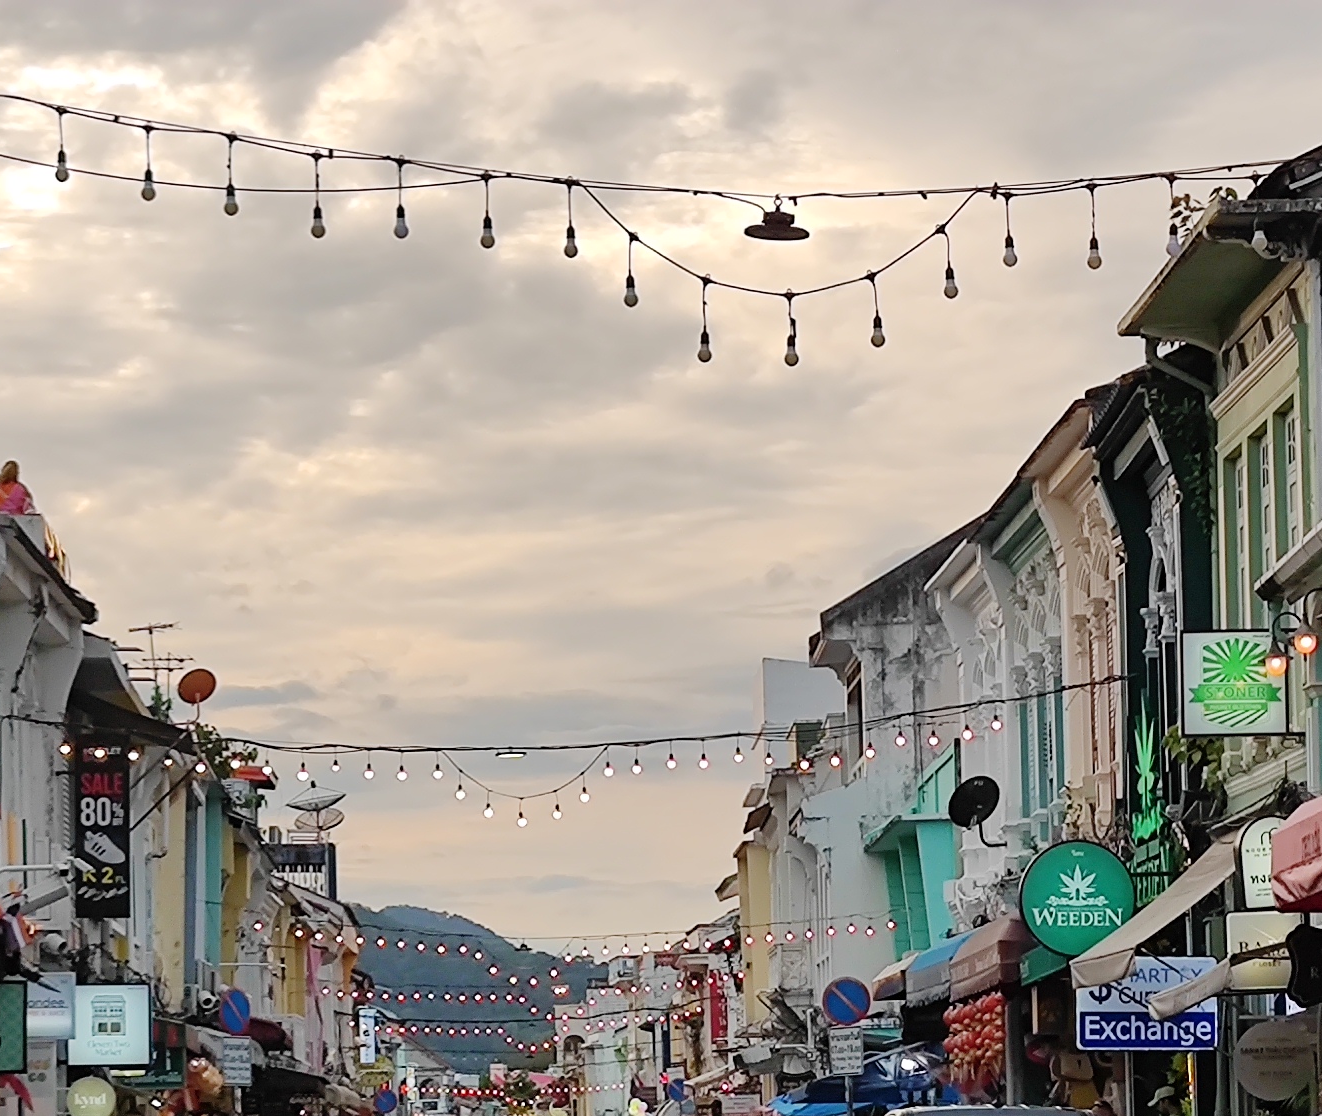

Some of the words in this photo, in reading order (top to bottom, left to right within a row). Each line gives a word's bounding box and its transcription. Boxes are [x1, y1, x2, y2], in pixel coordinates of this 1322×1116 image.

[1206, 686, 1265, 698] STONER
[81, 773, 124, 795] SALE
[1032, 907, 1123, 926] WEEDEN
[1084, 1016, 1212, 1046] Exchange
[74, 1093, 106, 1108] kynd
